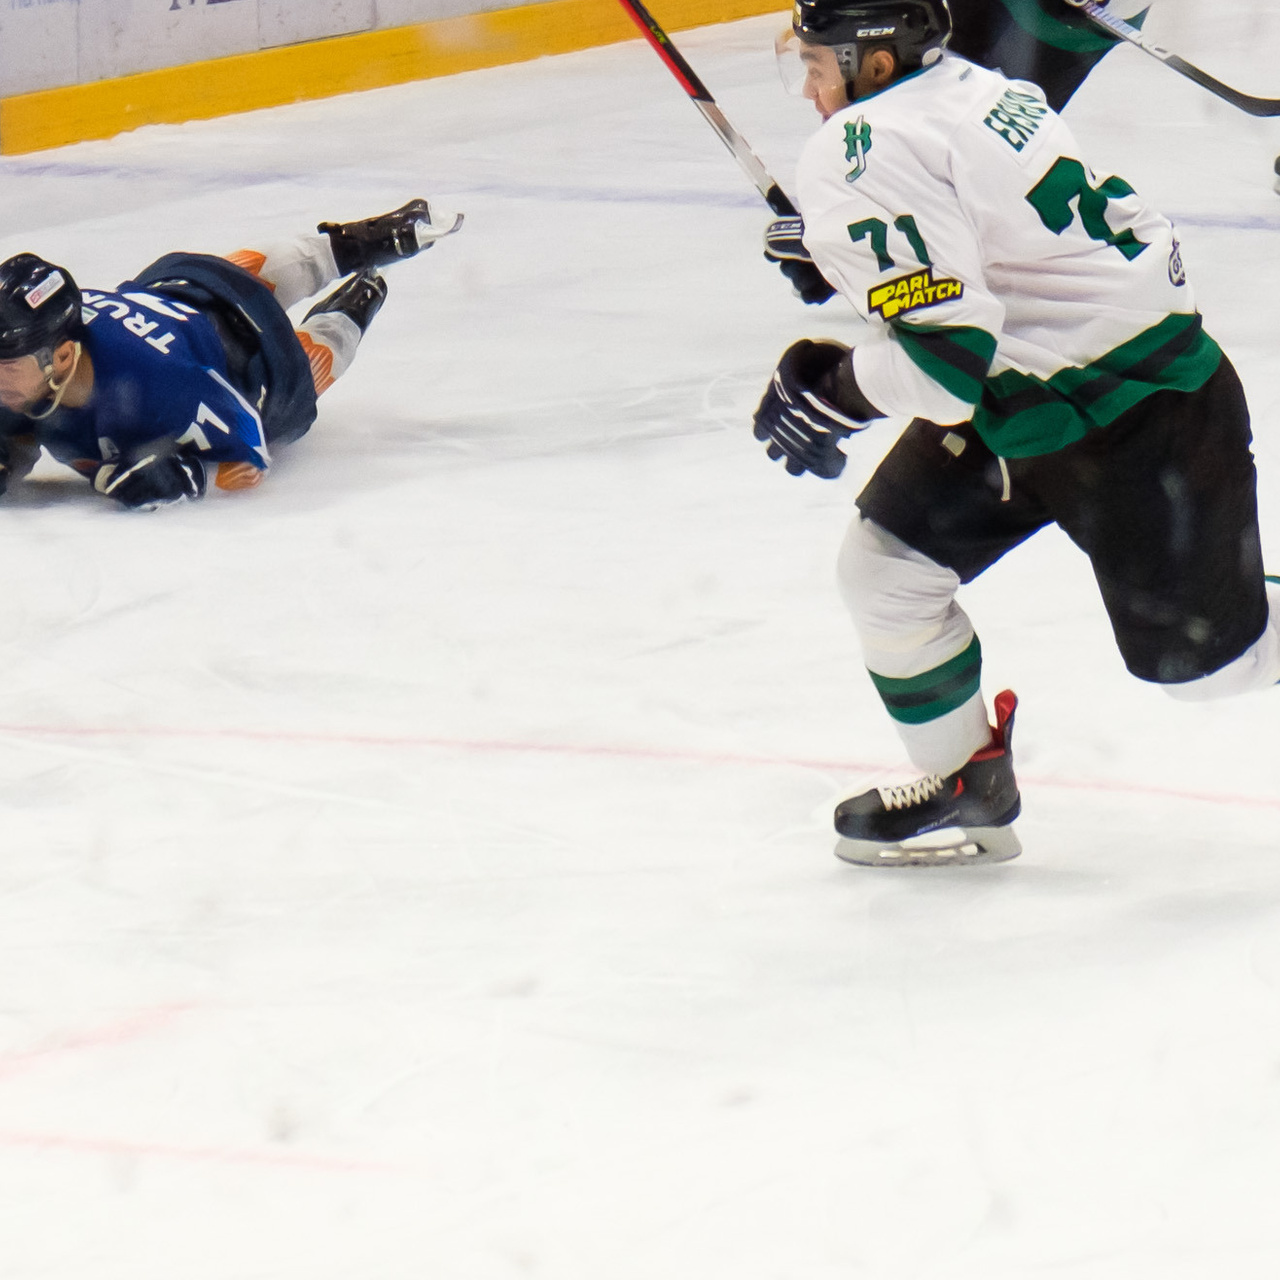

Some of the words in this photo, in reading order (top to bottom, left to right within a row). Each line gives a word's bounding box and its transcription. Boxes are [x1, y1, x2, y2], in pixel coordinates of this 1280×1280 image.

[856, 26, 896, 38] CCM
[847, 214, 934, 273] 71
[870, 272, 930, 309] PARI
[881, 282, 962, 319] MATCH
